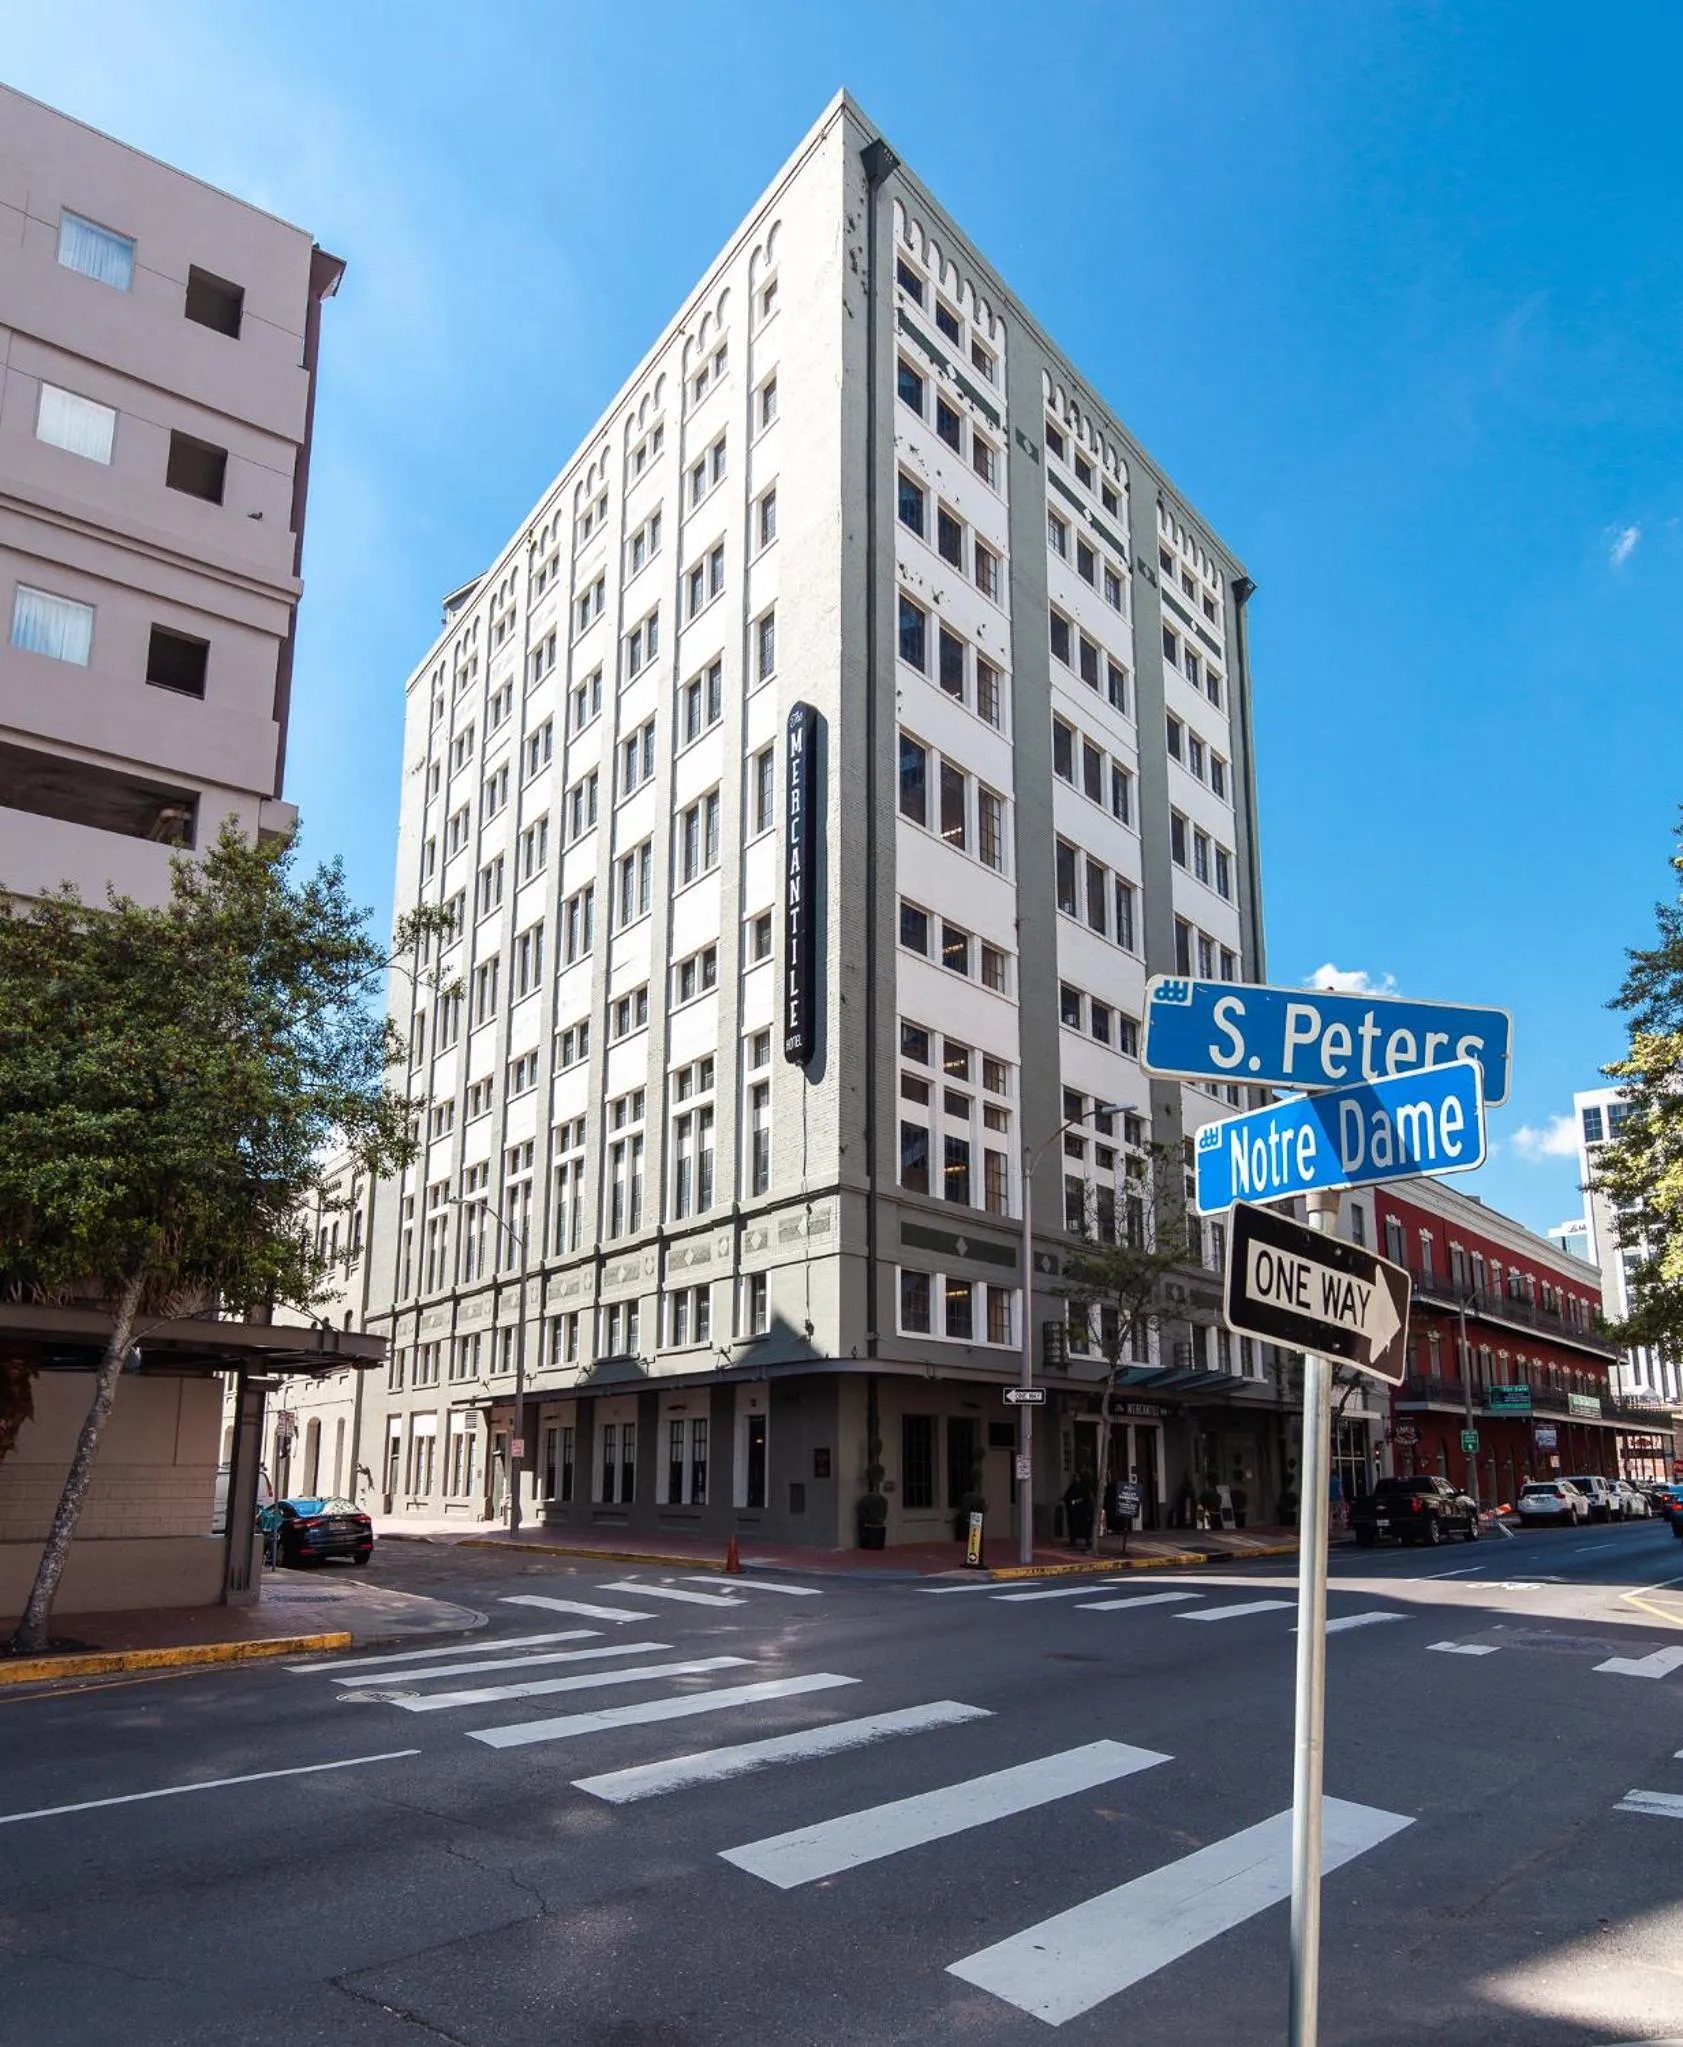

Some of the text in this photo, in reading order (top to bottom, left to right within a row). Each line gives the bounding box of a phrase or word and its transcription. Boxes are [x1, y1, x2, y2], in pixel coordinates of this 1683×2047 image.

[789, 727, 803, 1028] MERCANTILE
[786, 1034, 803, 1052] HOTEL
[1208, 996, 1485, 1080] S. Peters
[1230, 1095, 1465, 1197] Notre Dame
[1255, 1250, 1371, 1329] ONE WAY
